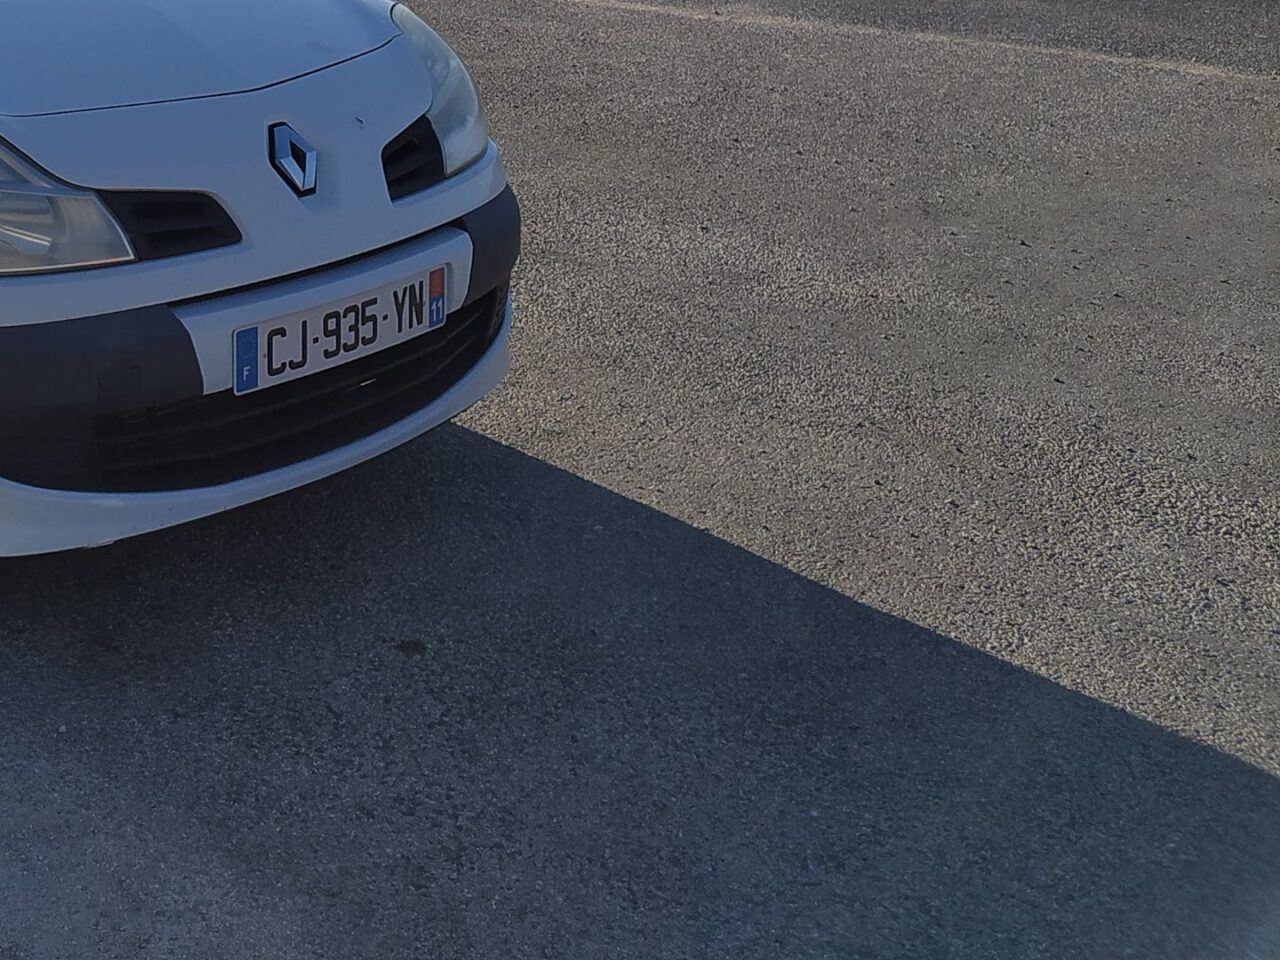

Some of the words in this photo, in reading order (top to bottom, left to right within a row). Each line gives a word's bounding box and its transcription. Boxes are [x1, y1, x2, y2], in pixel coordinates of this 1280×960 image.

[242, 365, 251, 382] F
[267, 280, 424, 377] CJ-935-YN
[431, 298, 443, 322] 11
